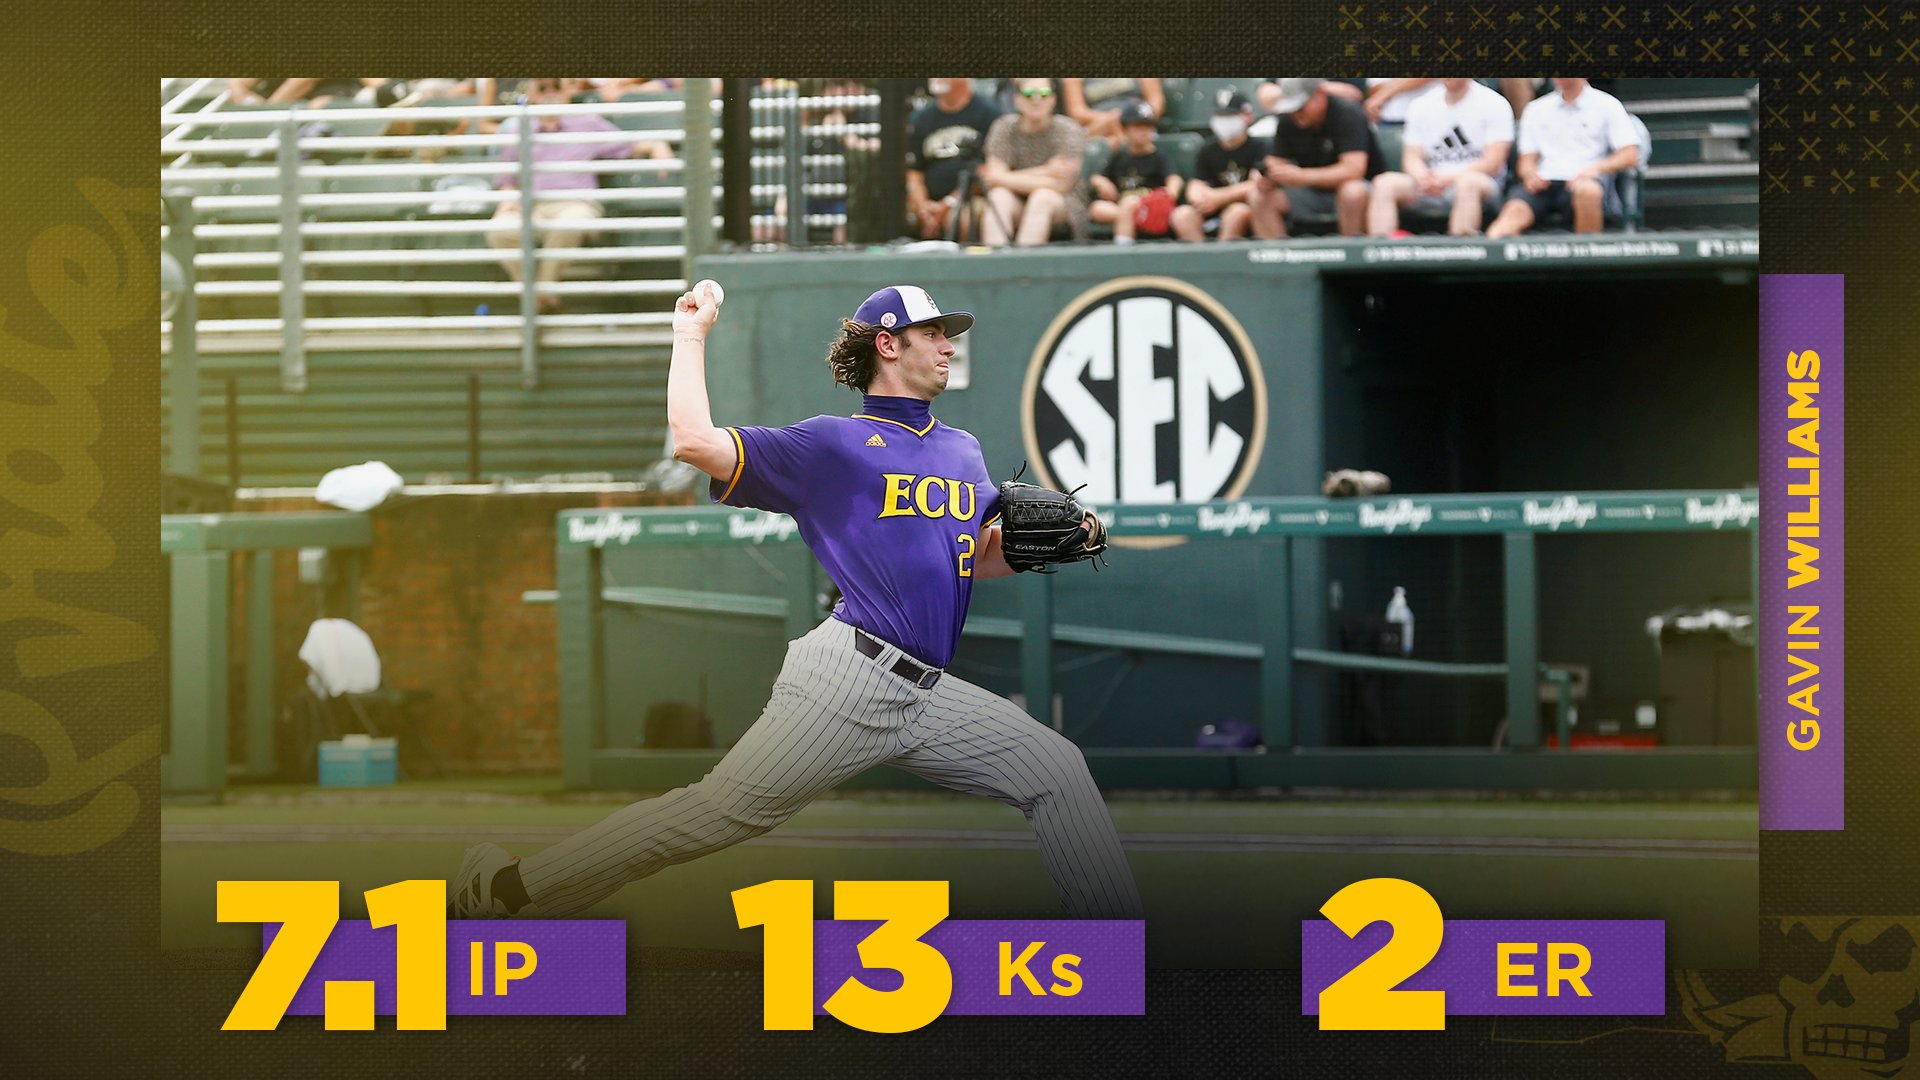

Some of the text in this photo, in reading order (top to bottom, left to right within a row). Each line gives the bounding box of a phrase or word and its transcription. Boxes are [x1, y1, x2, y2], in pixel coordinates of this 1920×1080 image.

[1042, 296, 1245, 503] SEC
[878, 474, 976, 521] ECU
[957, 534, 975, 579] 2
[1015, 544, 1056, 552] EASTON
